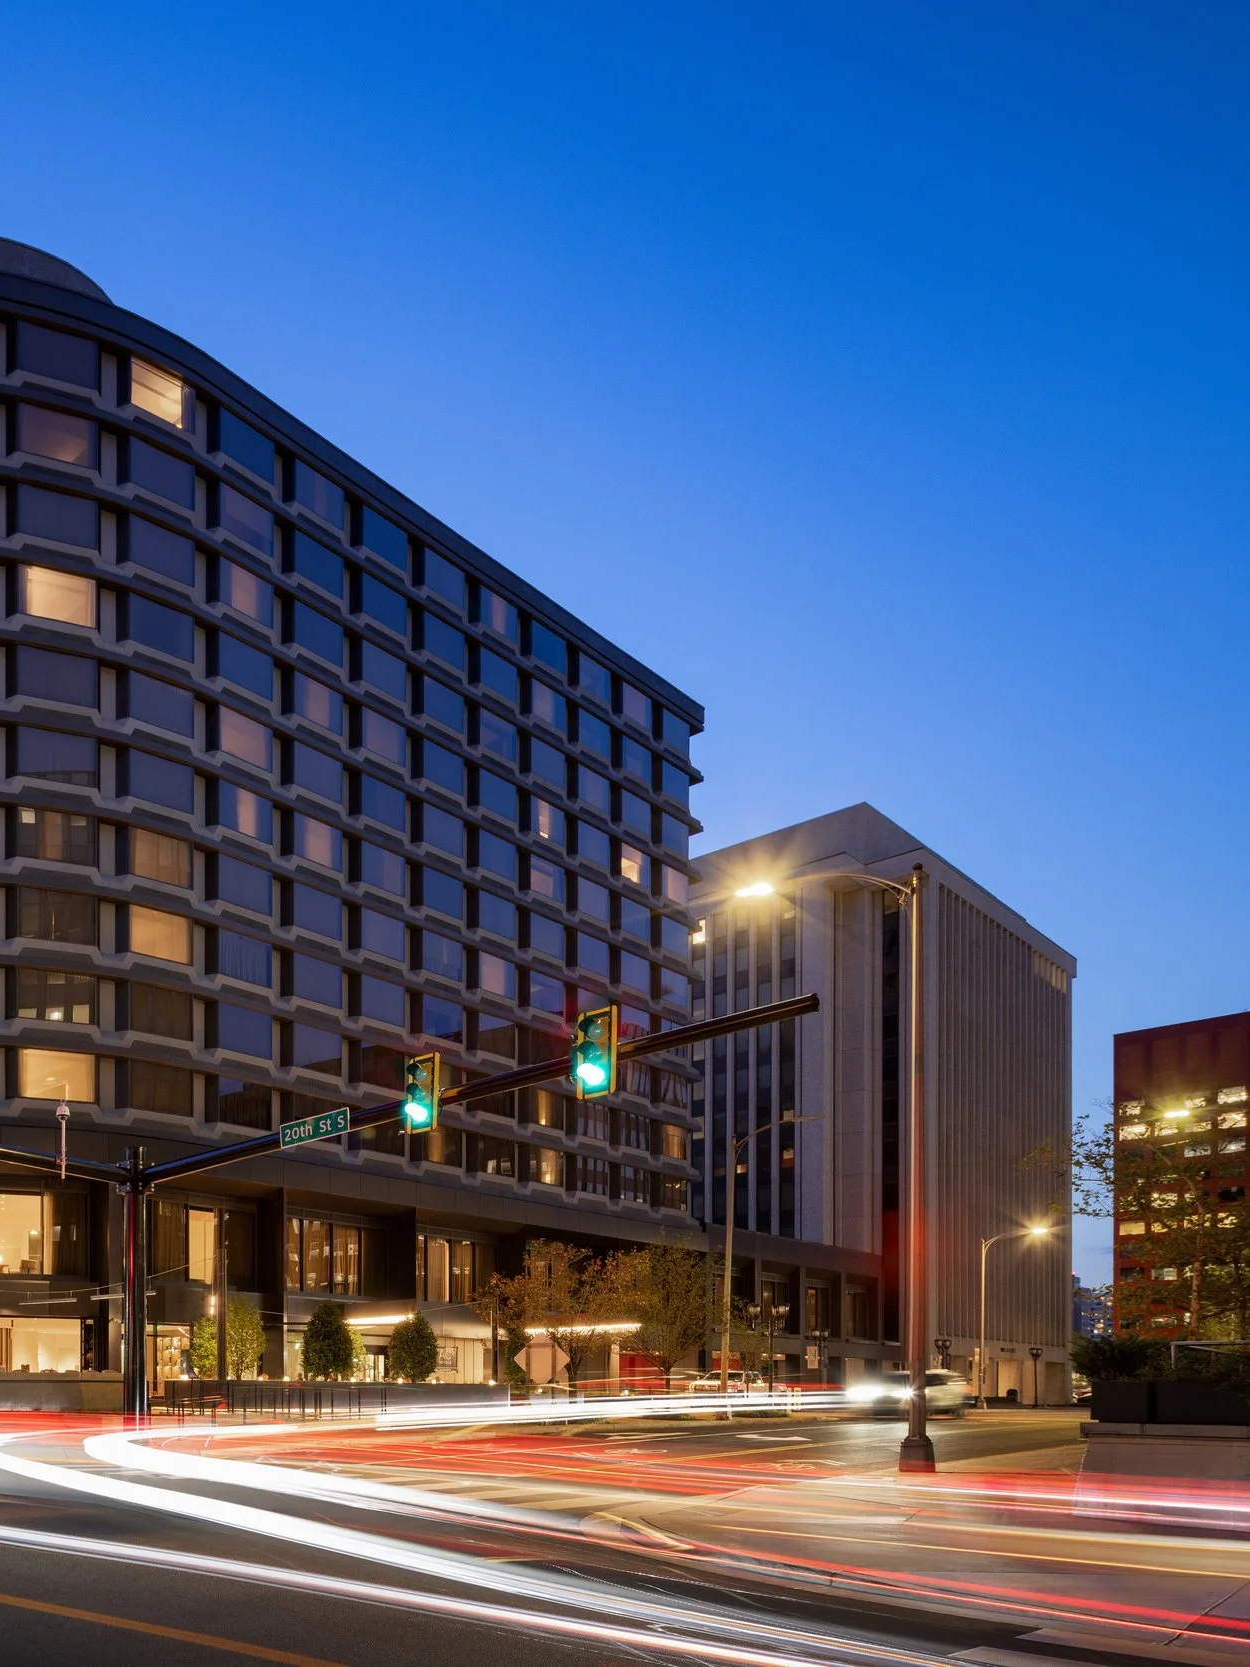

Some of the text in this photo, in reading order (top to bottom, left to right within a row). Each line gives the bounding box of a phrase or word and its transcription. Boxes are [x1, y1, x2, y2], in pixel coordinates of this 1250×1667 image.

[284, 1115, 345, 1142] 20th St S
